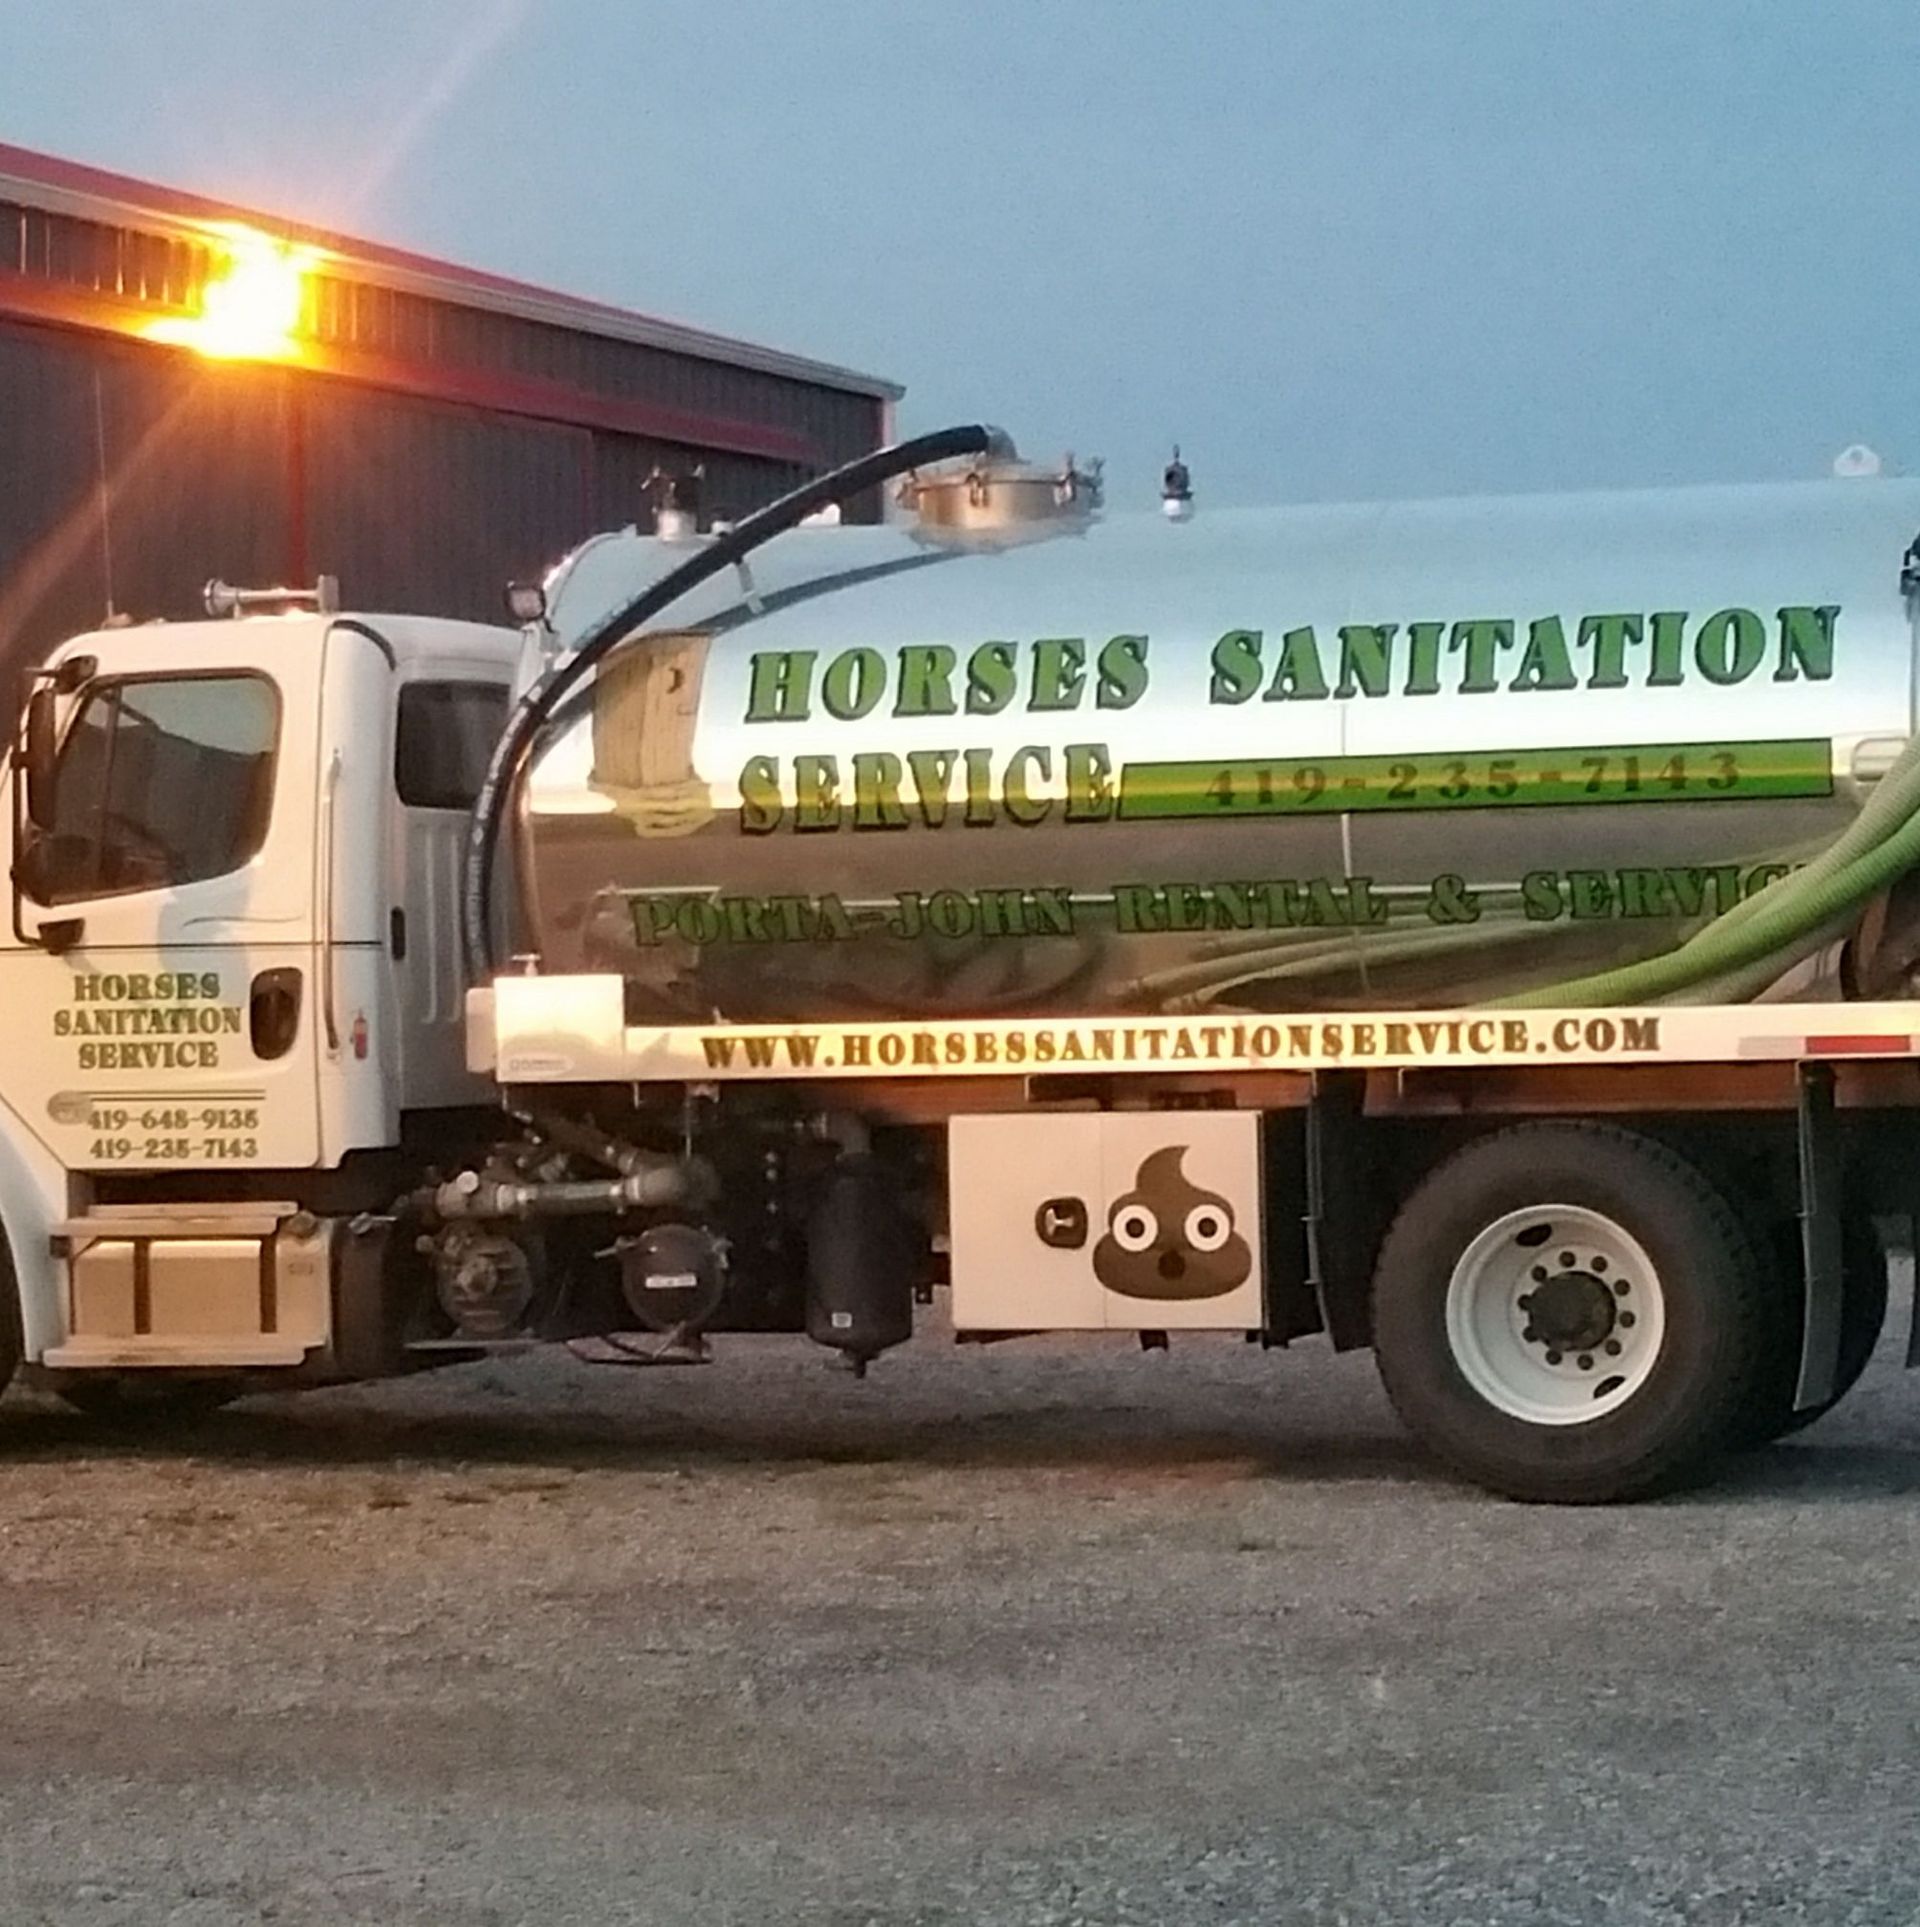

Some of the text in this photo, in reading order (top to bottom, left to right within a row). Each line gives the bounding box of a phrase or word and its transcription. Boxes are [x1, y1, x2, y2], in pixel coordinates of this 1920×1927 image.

[744, 605, 1841, 723] HORSES SANITATION
[739, 743, 1113, 836] SERVICE
[1205, 749, 1743, 806] 419-235-7143
[631, 888, 1075, 946] PORTA-JOHN
[1115, 874, 1388, 933] RENTAL
[1426, 872, 1482, 924] &
[73, 973, 220, 1001] HORSES
[53, 1007, 242, 1036] SANITATION
[701, 1017, 1661, 1069] WWW.HORSESSANITATIONSERVICE.COM
[78, 1041, 219, 1069] SERVICE
[90, 1137, 259, 1159] 419-235-7143
